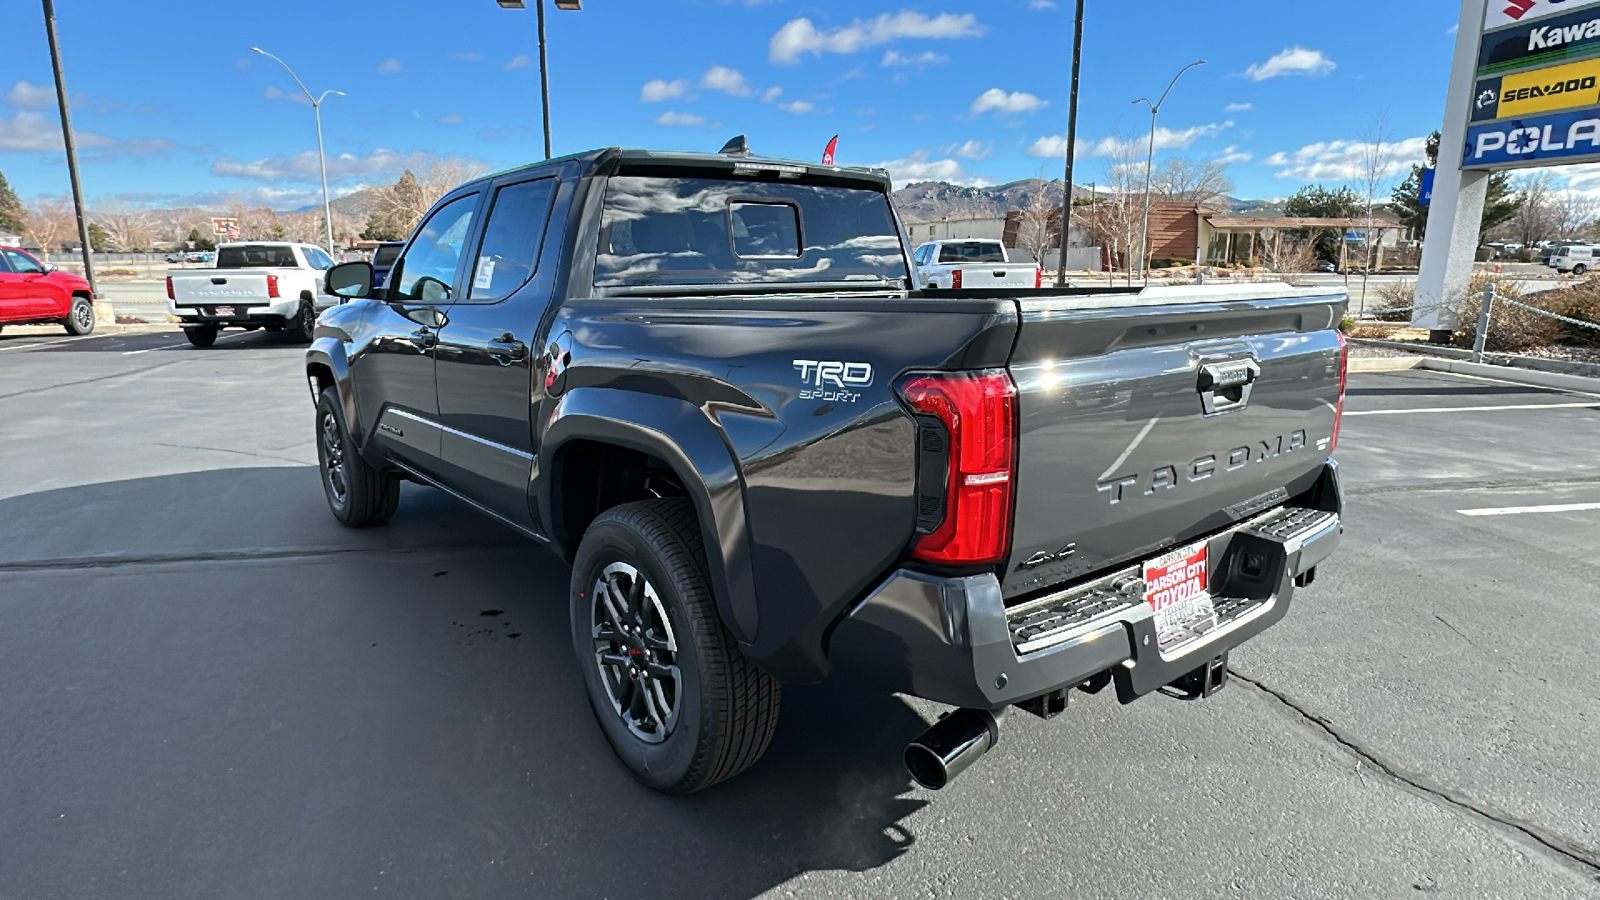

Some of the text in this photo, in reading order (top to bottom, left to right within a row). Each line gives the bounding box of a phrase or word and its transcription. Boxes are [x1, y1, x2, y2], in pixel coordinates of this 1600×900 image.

[1528, 18, 1600, 51] Kawa
[1474, 118, 1600, 159] POLA
[792, 359, 874, 388] TRD
[798, 389, 861, 403] SPORT
[1096, 429, 1306, 504] TACOMA
[1159, 547, 1194, 565] CARSON CITY
[1146, 567, 1187, 593] CARSON
[1186, 559, 1205, 579] CITY
[1152, 576, 1201, 612] TOYOTA
